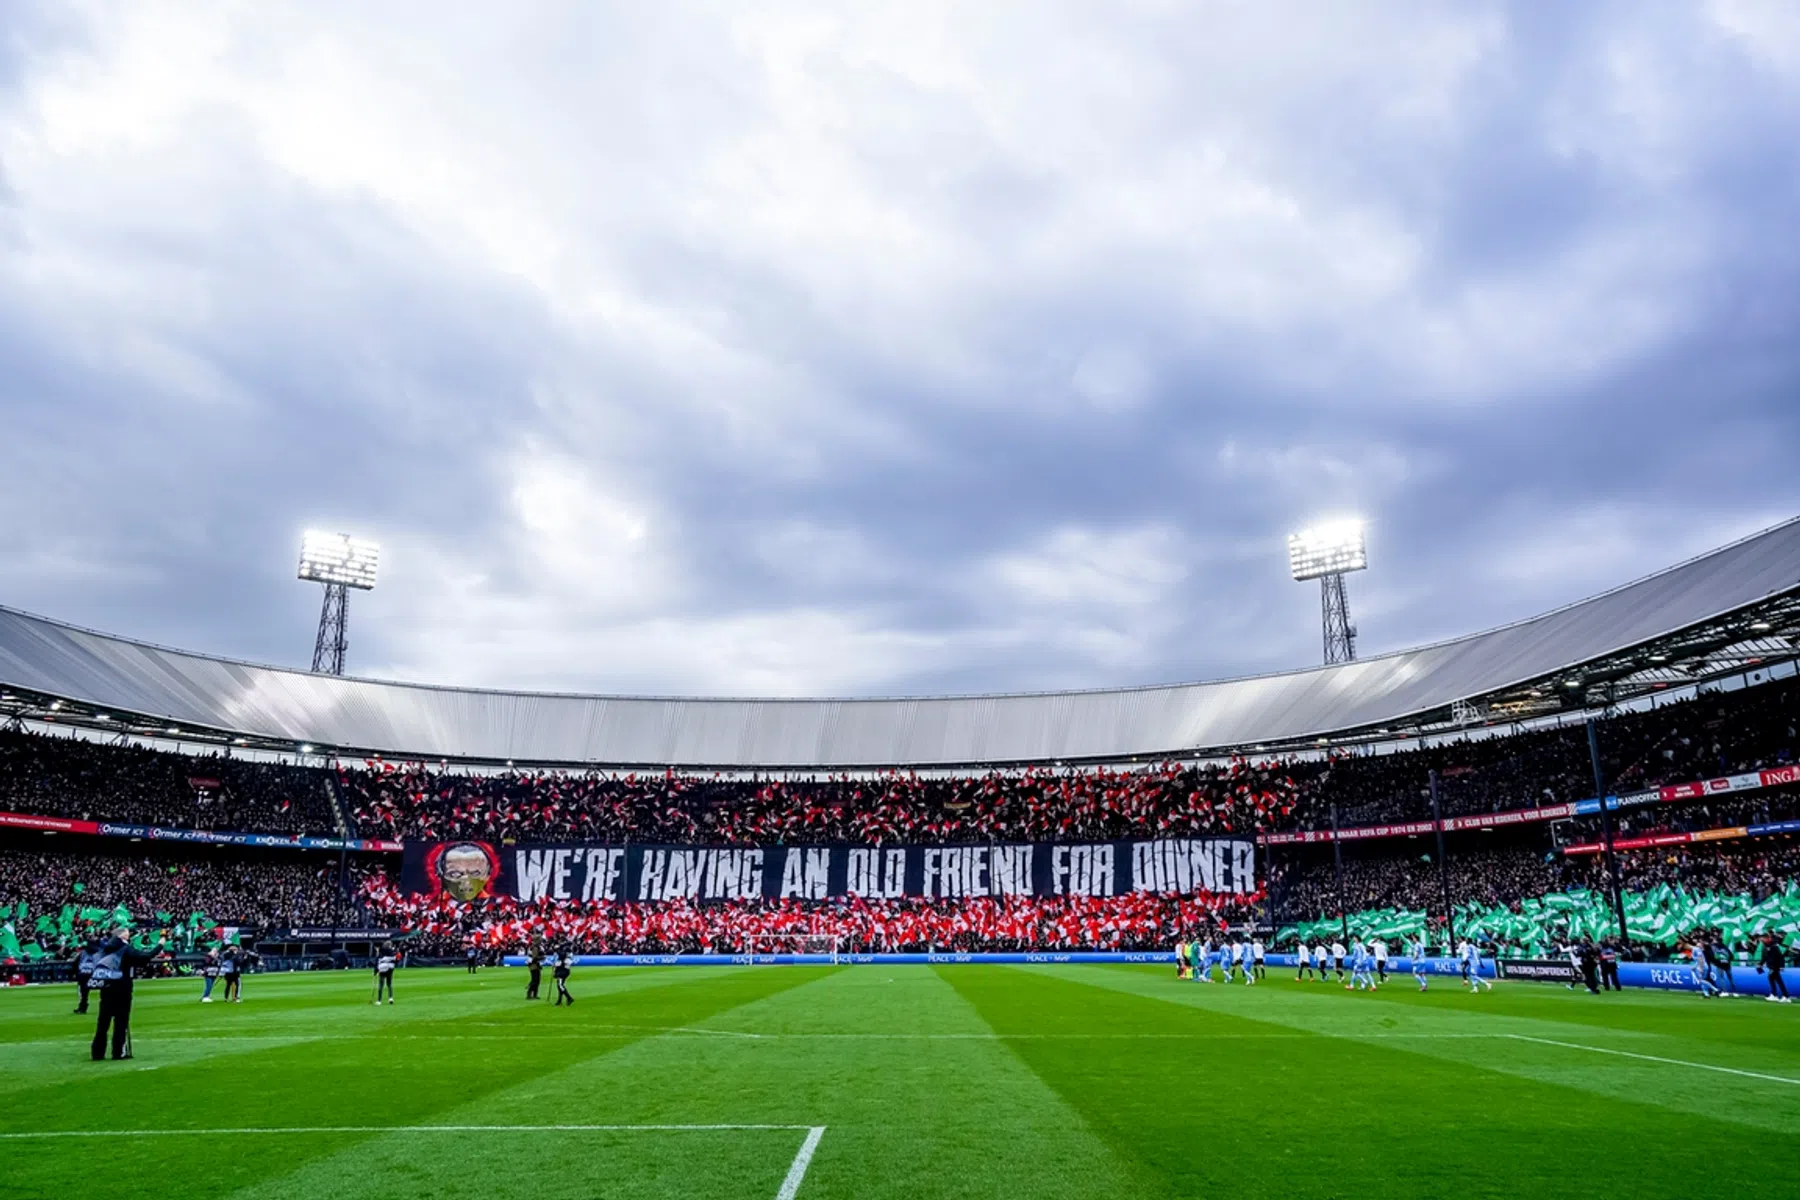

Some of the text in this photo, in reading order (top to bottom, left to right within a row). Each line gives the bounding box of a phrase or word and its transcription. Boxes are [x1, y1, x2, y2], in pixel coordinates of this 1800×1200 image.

[1765, 770, 1792, 786] ING
[1464, 818, 1480, 828] CLUB
[102, 823, 145, 837] Ormer ICT
[152, 827, 182, 840] Ormer
[1359, 828, 1375, 838] UEFA
[1376, 827, 1389, 837] CUP
[1390, 825, 1405, 836] 1974
[1406, 825, 1416, 834] EN
[1417, 823, 1433, 833] 2002
[234, 836, 247, 844] ICT
[515, 839, 1256, 902] WE'RE HAVING AN OLD FRIEND FOR DINNER
[1434, 961, 1452, 973] PEACE
[1536, 966, 1572, 977] CONFERENCE
[1651, 968, 1683, 985] PEACE
